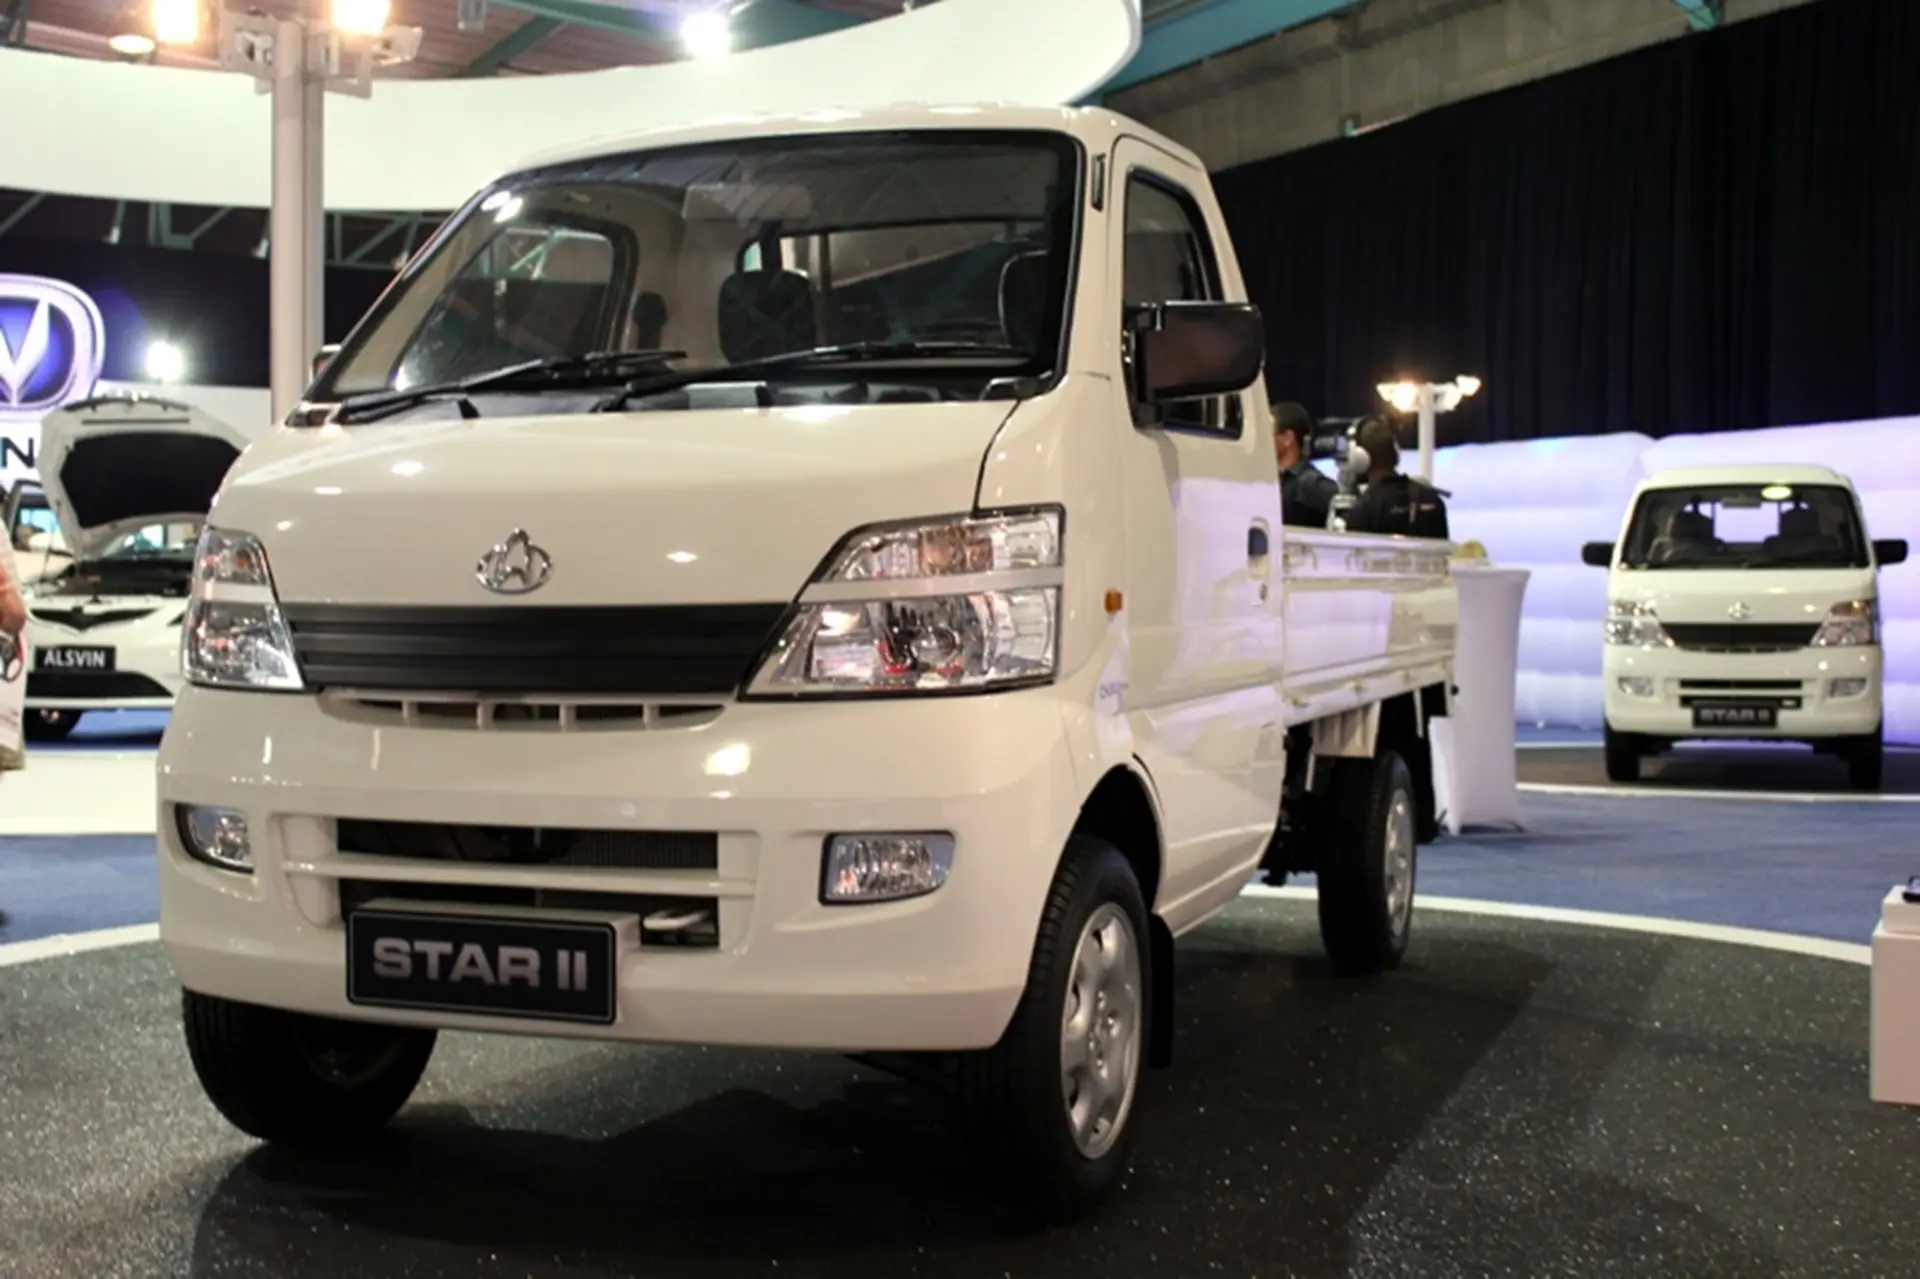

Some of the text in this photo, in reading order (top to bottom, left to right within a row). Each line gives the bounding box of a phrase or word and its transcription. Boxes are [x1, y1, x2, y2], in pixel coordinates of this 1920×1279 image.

[43, 649, 105, 668] ALSVIN
[373, 937, 588, 992] STAR II
